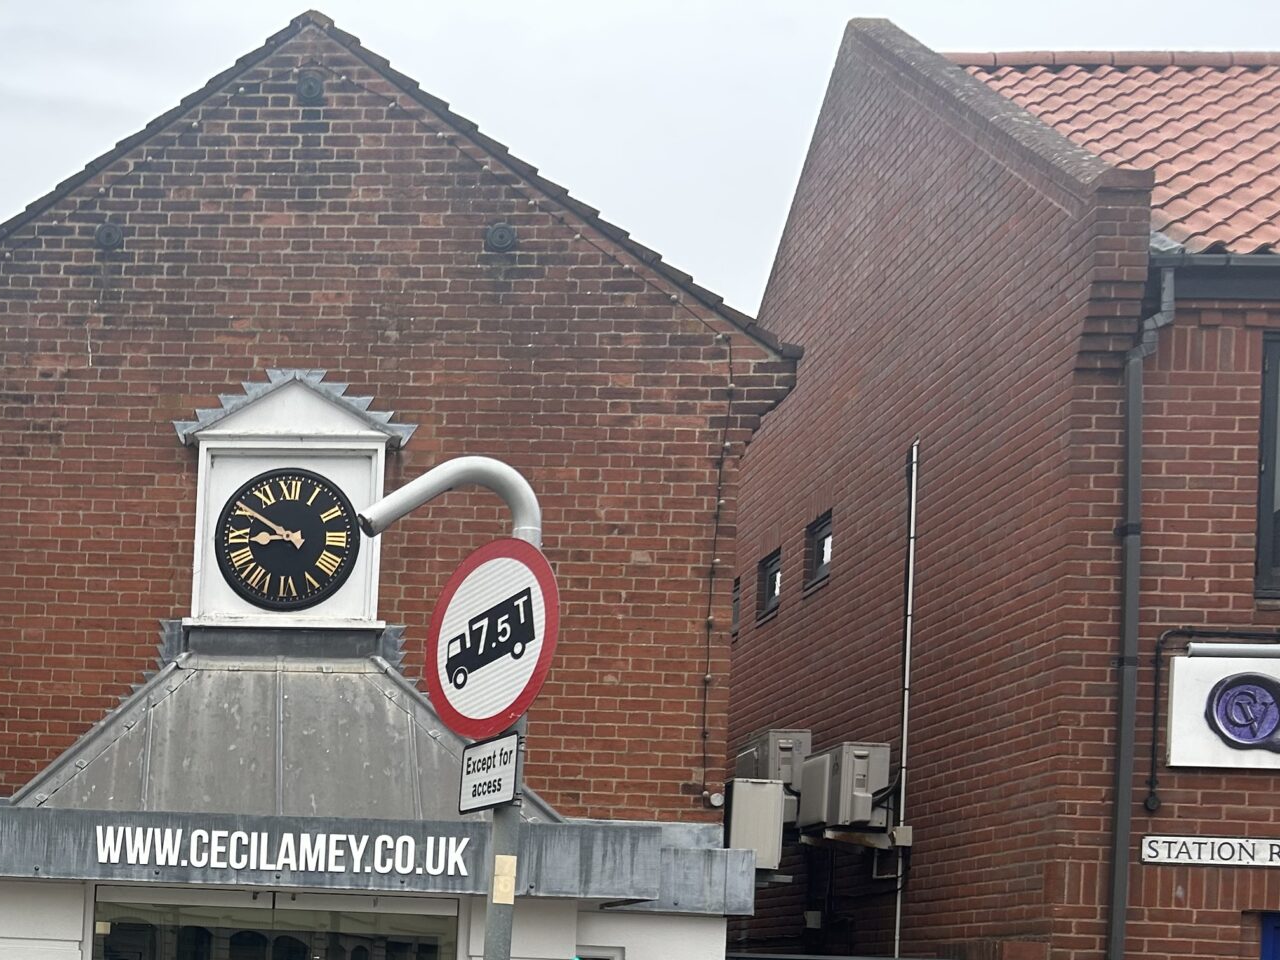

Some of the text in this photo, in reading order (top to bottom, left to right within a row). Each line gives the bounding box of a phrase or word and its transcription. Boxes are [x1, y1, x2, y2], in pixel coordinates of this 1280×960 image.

[472, 596, 528, 655] 7.5 T
[466, 747, 513, 776] Except for
[472, 777, 502, 798] access
[96, 825, 470, 876] WWW.CECILAMEY.CO.UK
[1147, 839, 1256, 861] STATION
